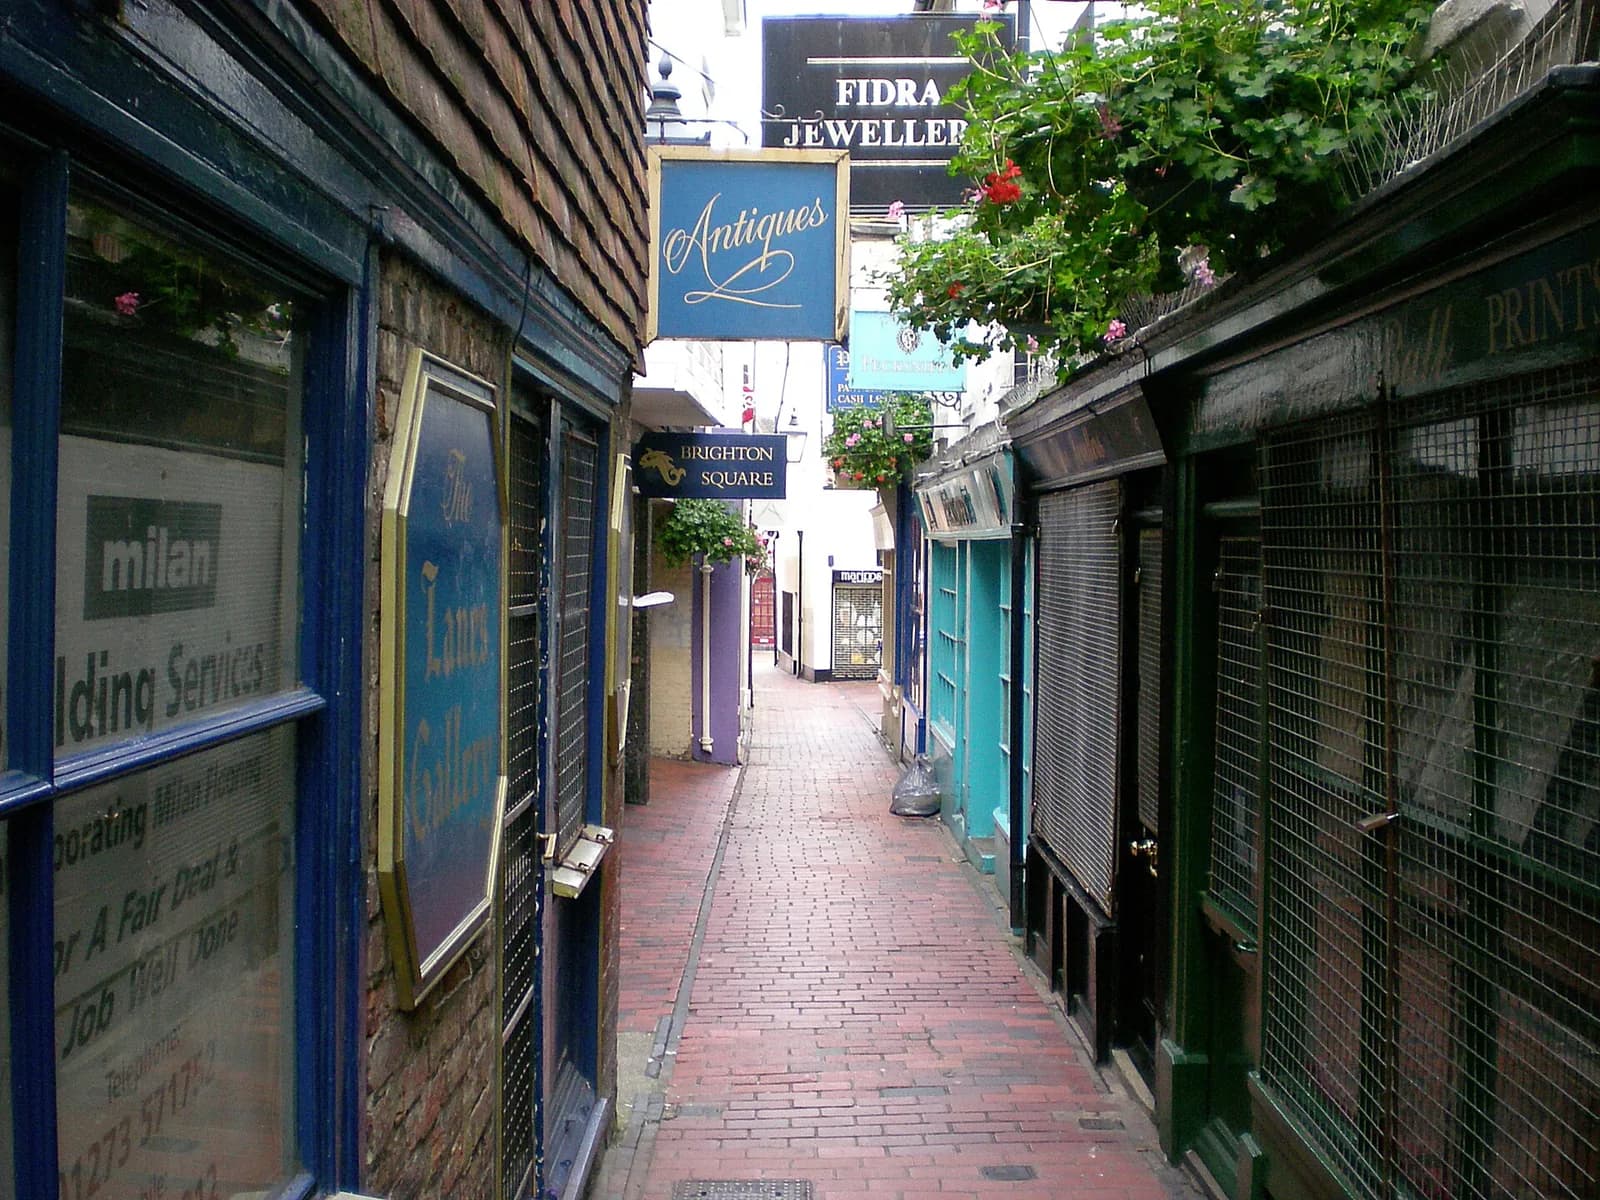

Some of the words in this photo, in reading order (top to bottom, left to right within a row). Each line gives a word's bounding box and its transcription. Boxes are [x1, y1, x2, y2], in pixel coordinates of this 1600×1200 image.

[835, 78, 942, 107] FIDRA
[783, 119, 988, 147] JEWELLER
[662, 191, 829, 300] Antiques
[837, 393, 865, 404] CASH
[680, 445, 774, 462] BRIGHTON
[701, 470, 774, 490] SQUARE
[102, 525, 211, 593] milan
[85, 904, 109, 961] A
[117, 876, 167, 944] Fair
[171, 842, 221, 912] Deal
[61, 988, 115, 1060] Job
